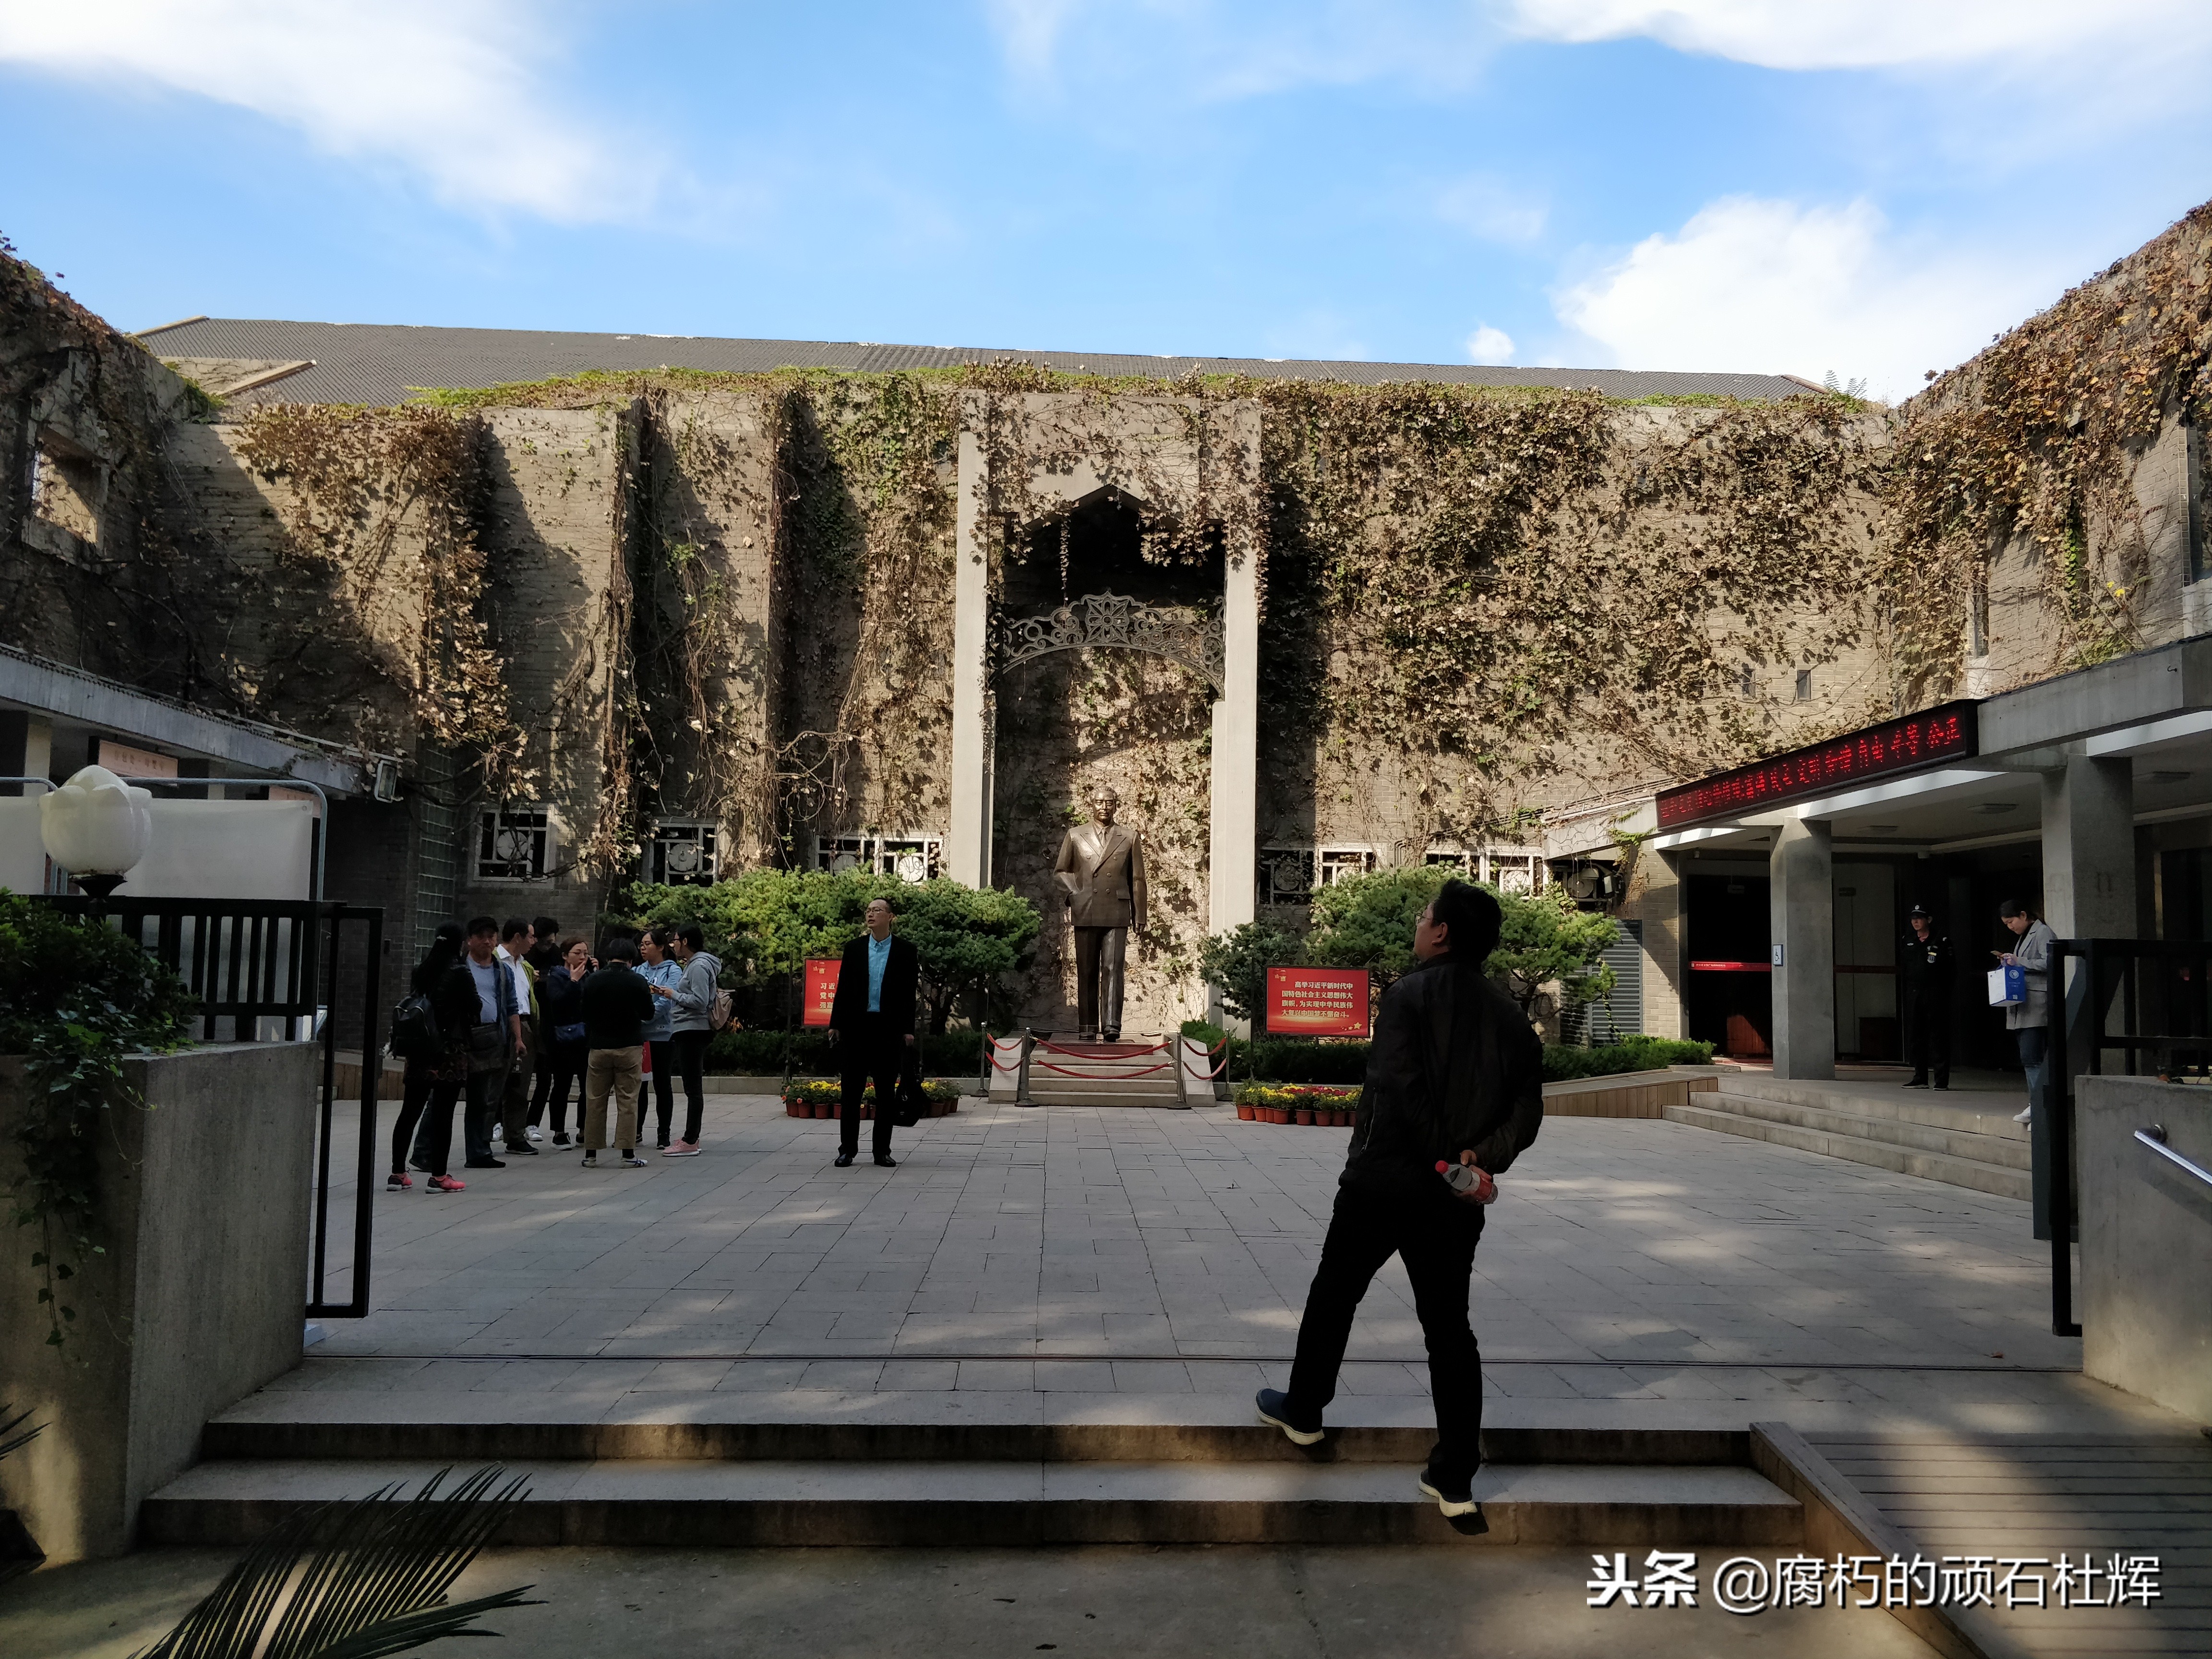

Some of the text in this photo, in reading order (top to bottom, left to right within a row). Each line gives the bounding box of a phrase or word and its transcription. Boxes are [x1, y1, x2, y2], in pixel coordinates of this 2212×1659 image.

[1295, 981, 1353, 990] 高举习近平新时代中
[1282, 990, 1353, 999] 国特色社会主义思想伟大
